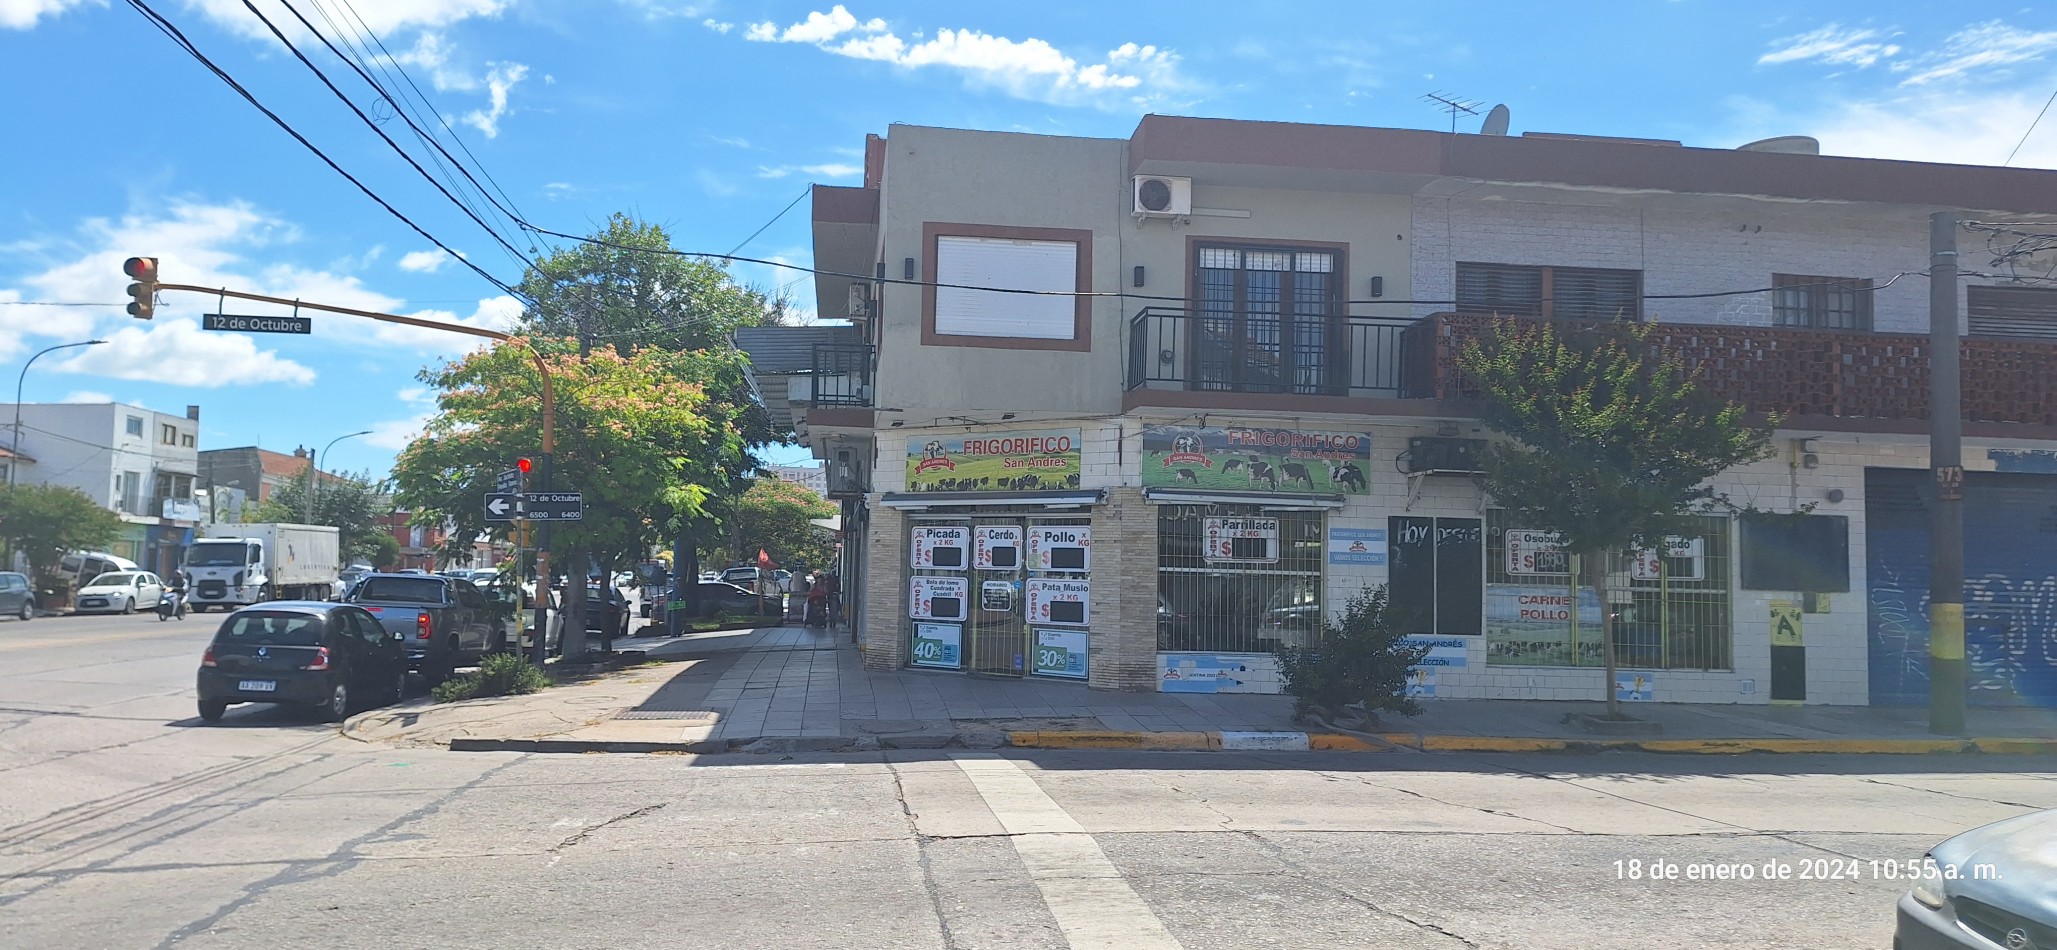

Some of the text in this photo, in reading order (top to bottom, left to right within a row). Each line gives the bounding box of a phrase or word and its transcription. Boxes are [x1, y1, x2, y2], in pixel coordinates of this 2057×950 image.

[212, 316, 302, 331] 12 de Octubre
[962, 435, 1071, 456] FRIGORIFICO
[1228, 430, 1360, 449] FRIGORIFICO
[1290, 448, 1356, 460] San Andres
[1004, 456, 1067, 468] San Andres
[1936, 466, 1963, 482] 573
[1222, 519, 1275, 530] Parrillada
[926, 529, 960, 538] Picada
[988, 530, 1014, 540] Cerdo
[1044, 531, 1076, 542] Pollo
[925, 549, 931, 563] $
[985, 549, 991, 563] $
[1042, 550, 1050, 565] $
[1042, 583, 1089, 592] Pata Muslo
[1519, 595, 1571, 605] CARNE
[1041, 603, 1049, 618] $
[1520, 610, 1569, 620] POLLO
[1431, 639, 1463, 647] ANDRÉS
[914, 642, 941, 658] 40%
[1038, 650, 1065, 667] 30%
